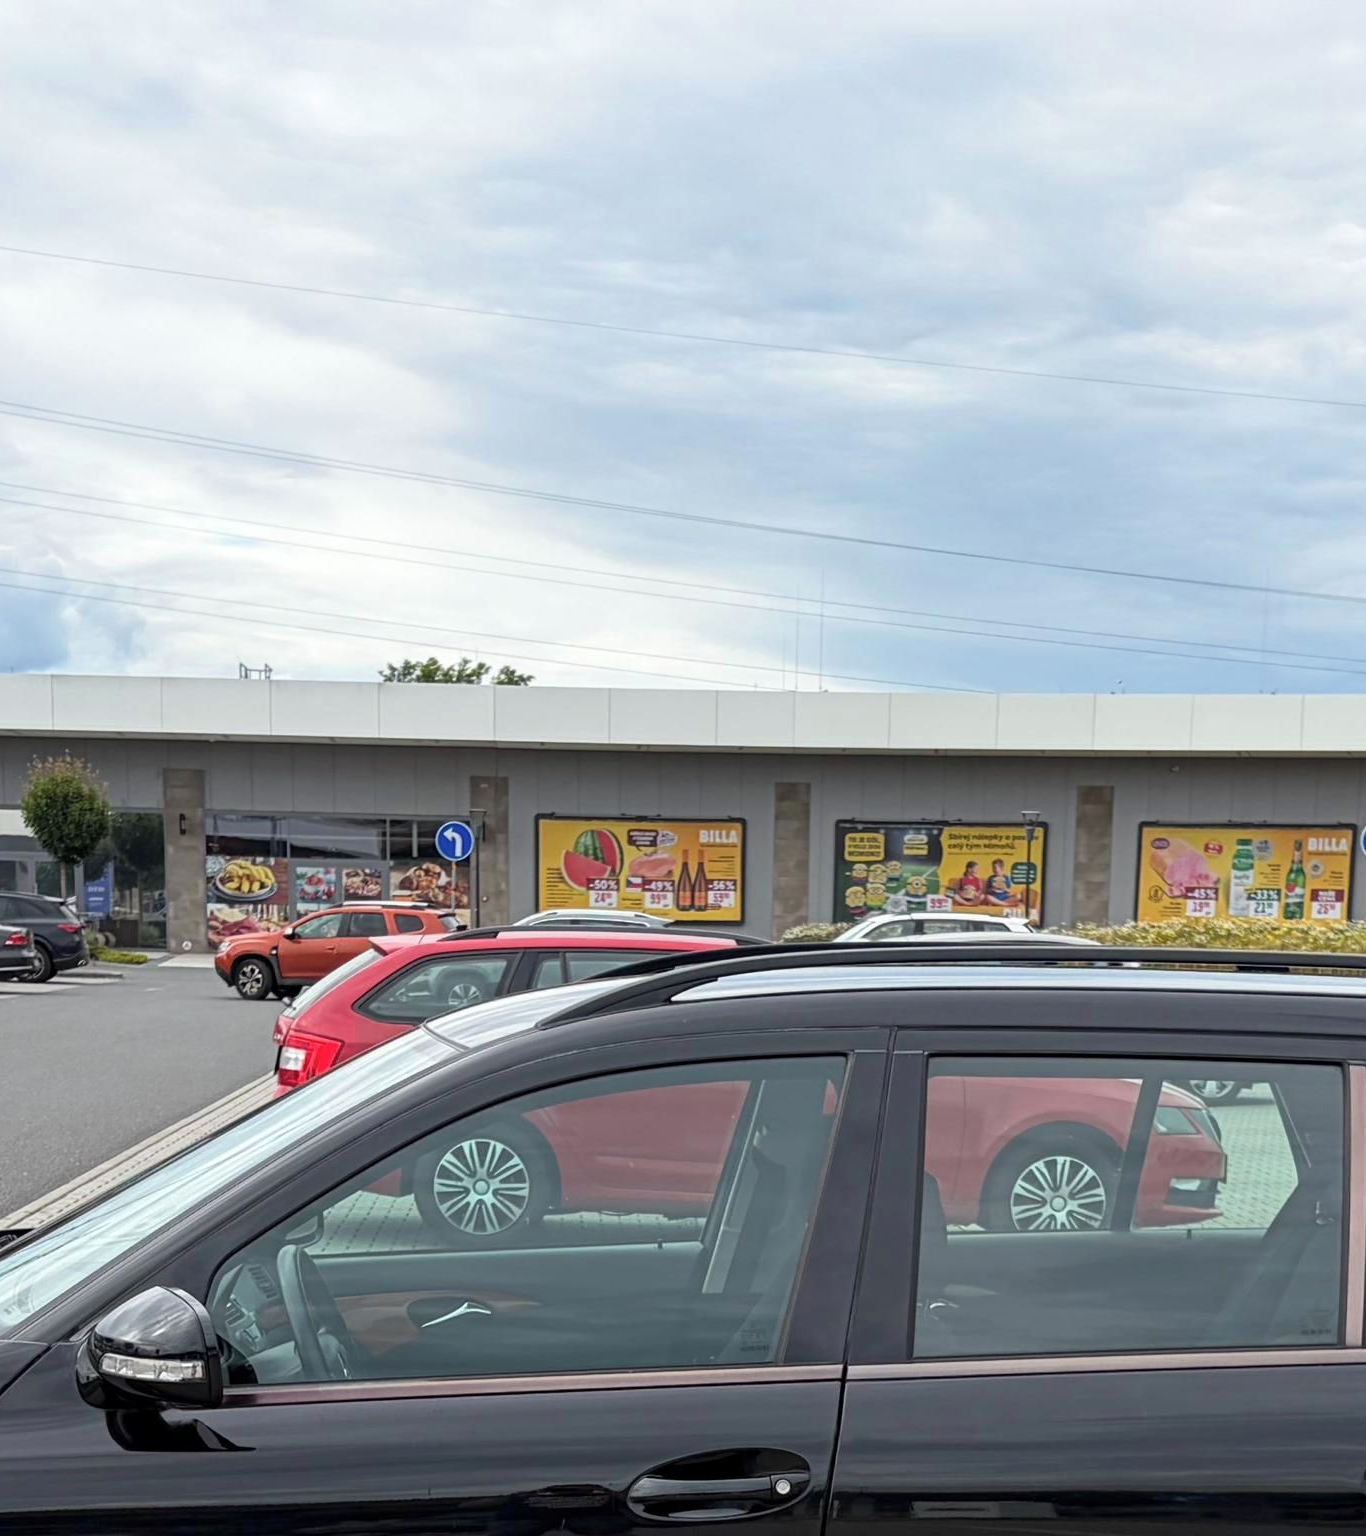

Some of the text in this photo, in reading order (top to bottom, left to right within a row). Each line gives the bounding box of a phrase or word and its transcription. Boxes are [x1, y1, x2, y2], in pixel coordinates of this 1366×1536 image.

[699, 830, 738, 843] BILLA
[1308, 838, 1348, 851] BILLA
[589, 879, 618, 890] -50%
[644, 881, 673, 891] -49%
[708, 880, 735, 891] -56%
[1186, 888, 1217, 899] -45%
[1250, 889, 1278, 900] -33%
